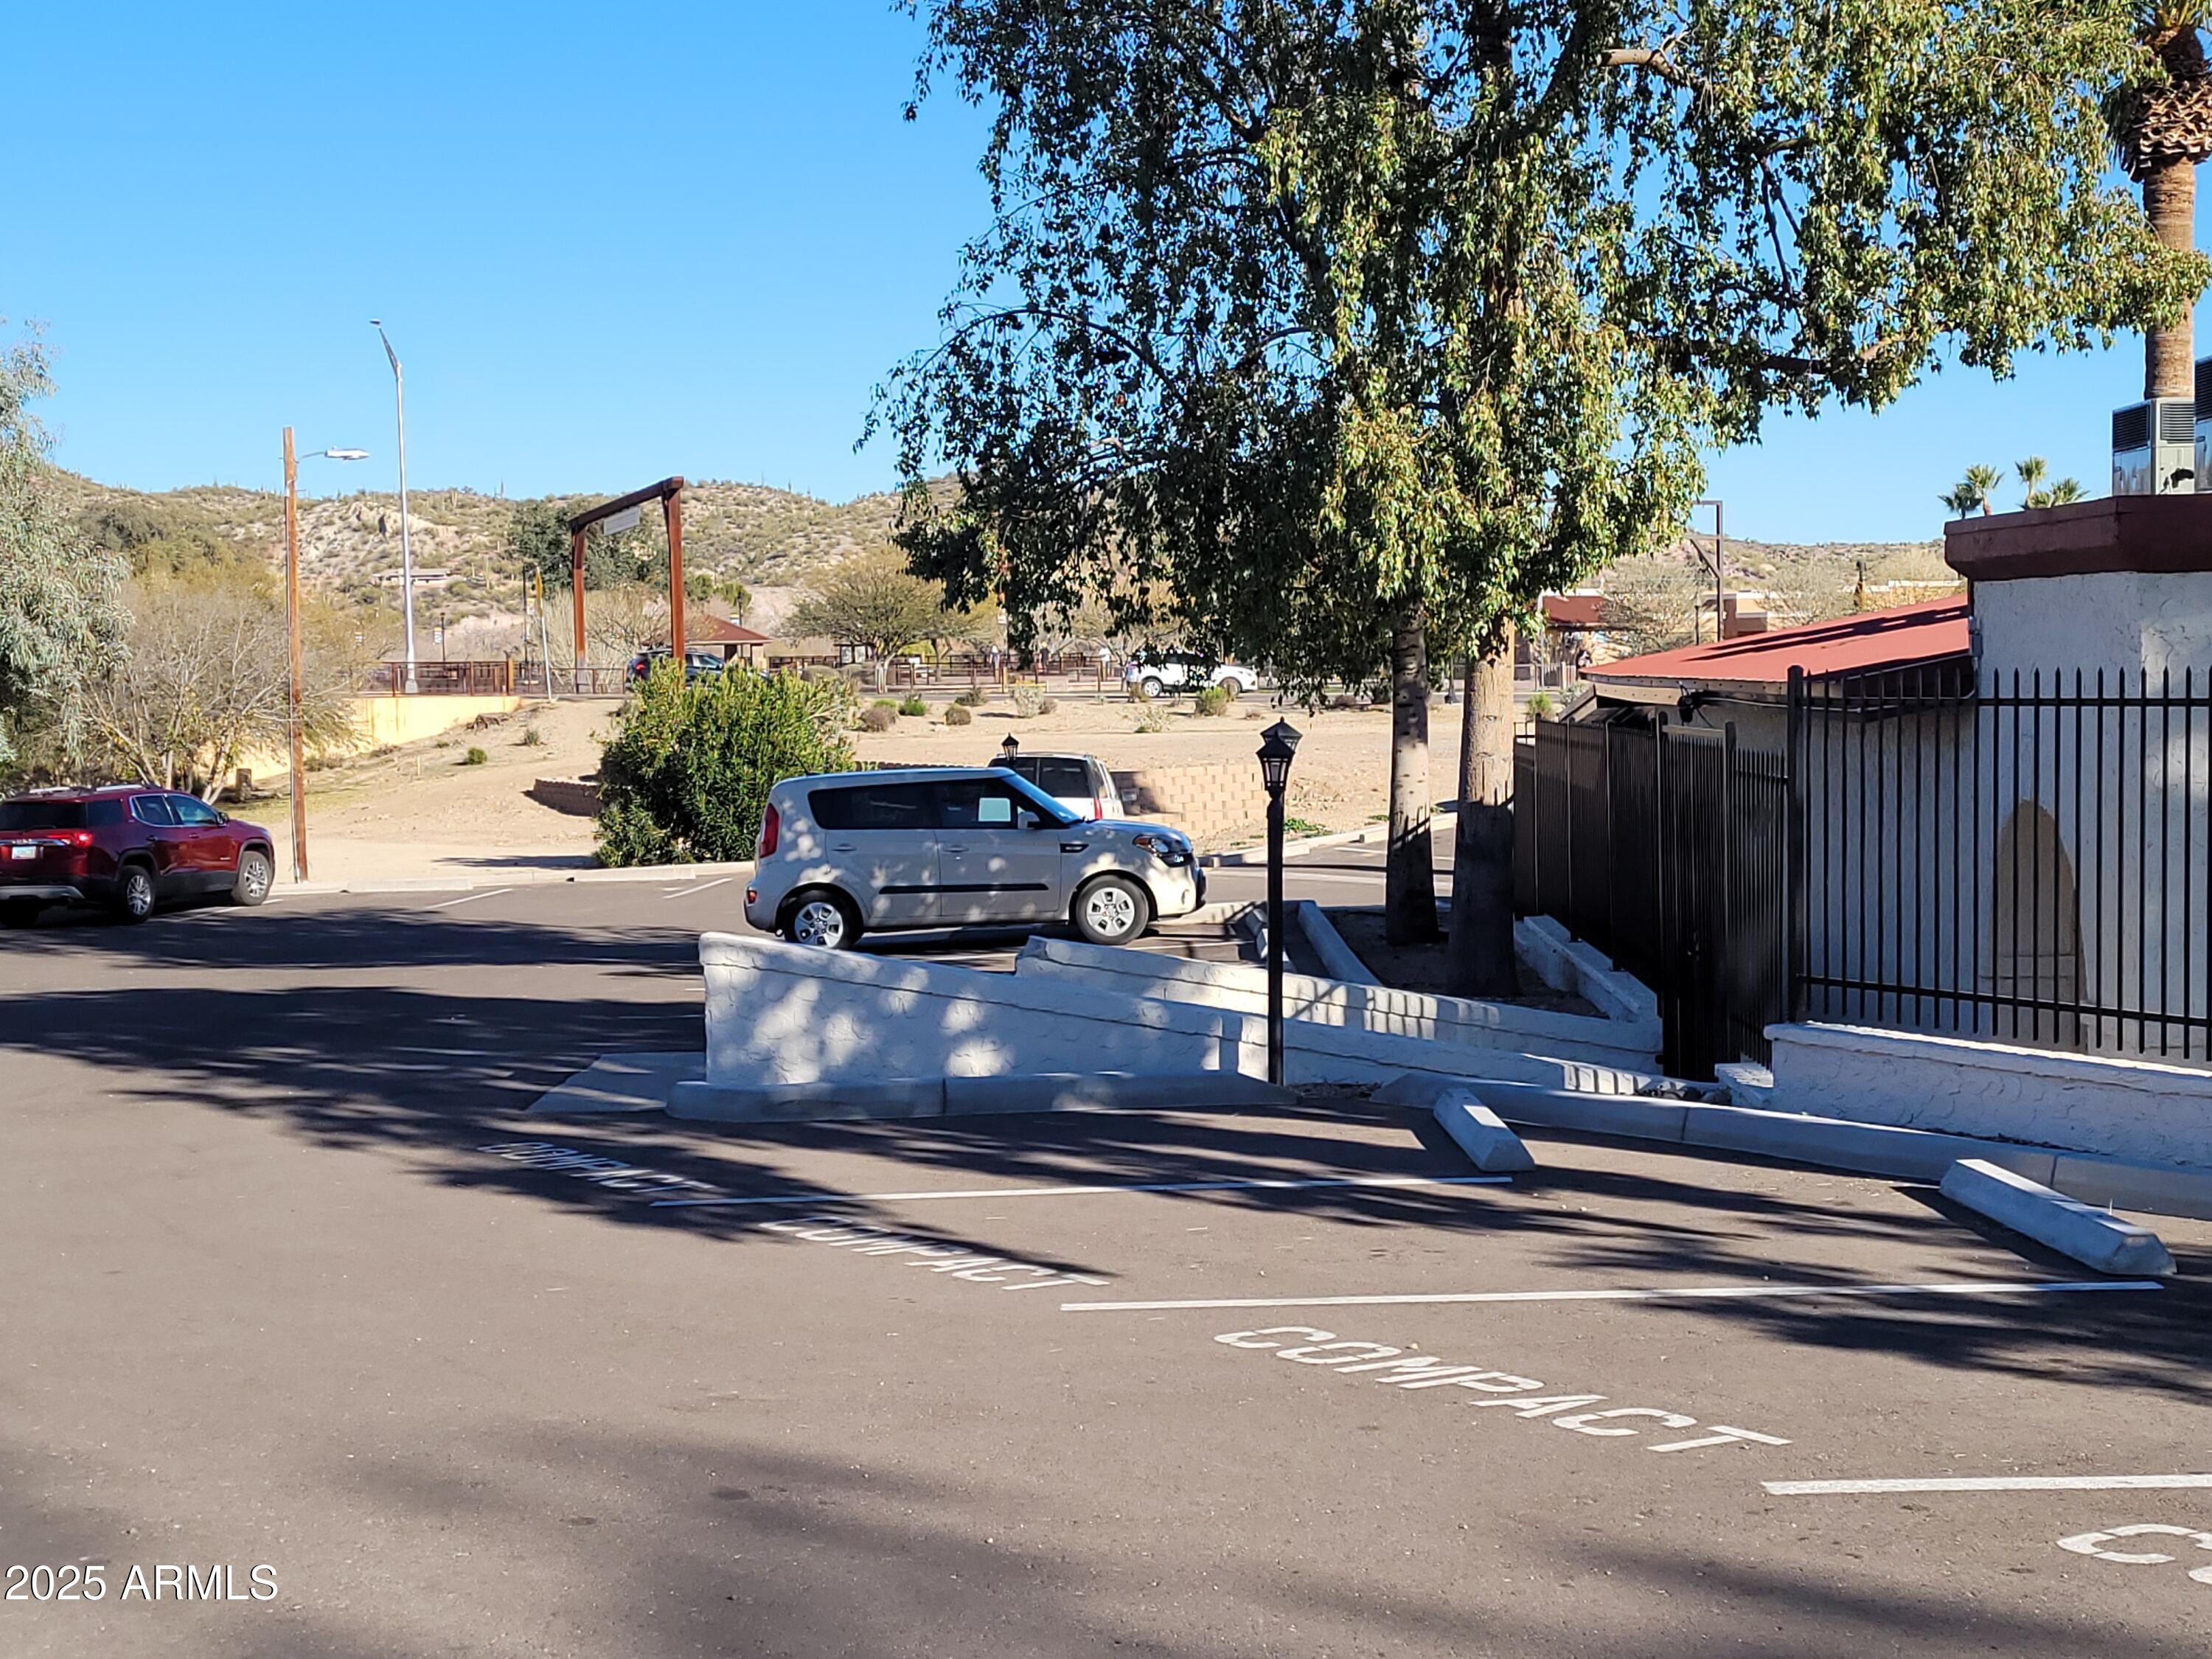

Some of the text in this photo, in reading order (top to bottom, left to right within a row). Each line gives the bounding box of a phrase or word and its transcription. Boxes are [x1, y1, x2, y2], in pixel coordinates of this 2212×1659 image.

[476, 1141, 717, 1194] COMPACT
[759, 1215, 1110, 1291] COMPACT
[1213, 1326, 1794, 1453] COMPACT
